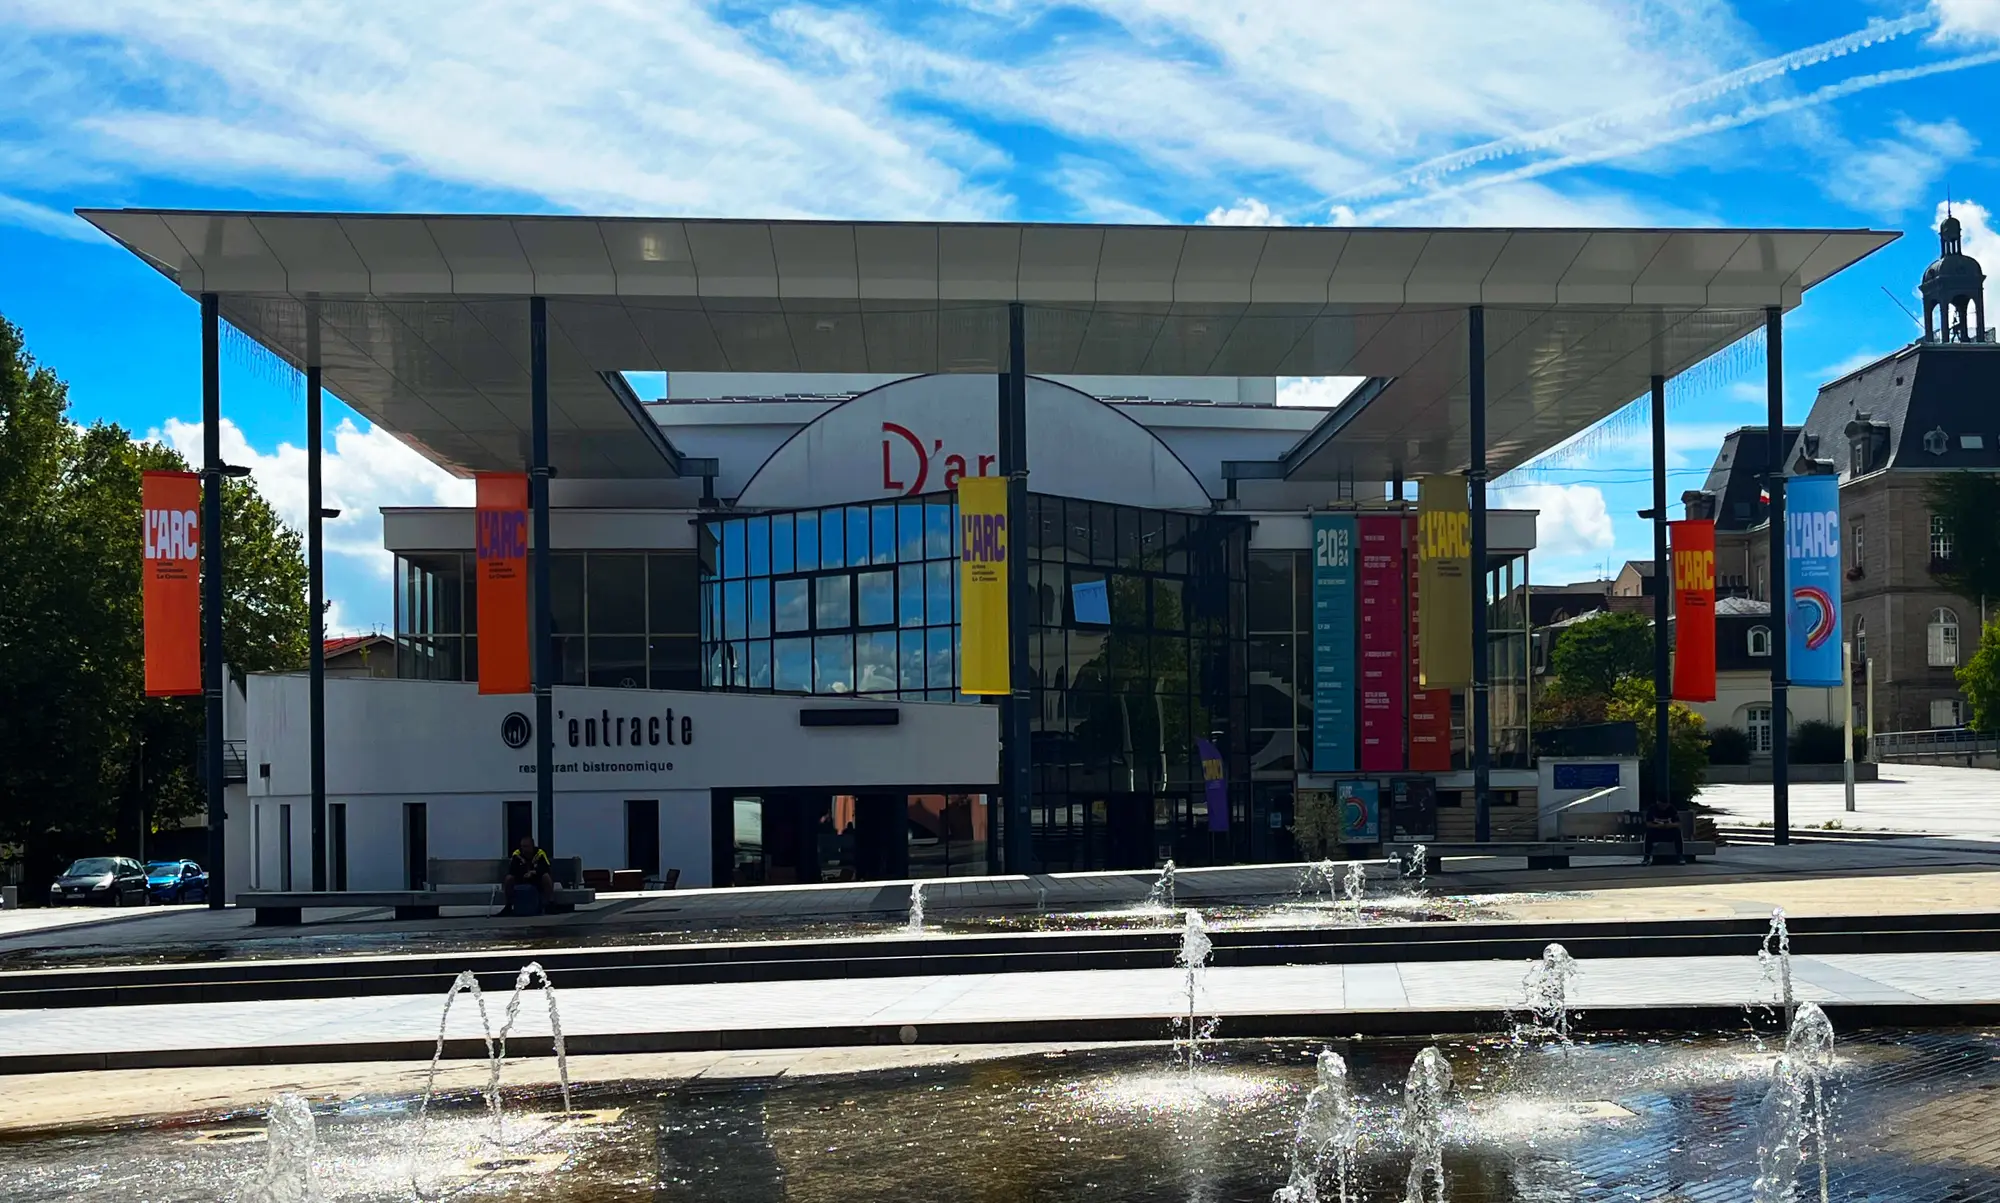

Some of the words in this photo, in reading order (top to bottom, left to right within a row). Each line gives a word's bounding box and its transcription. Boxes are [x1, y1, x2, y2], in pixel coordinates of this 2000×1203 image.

[144, 509, 197, 561] L'ARC
[478, 510, 525, 559] L'ARC
[961, 514, 1005, 562] L'ARC
[1317, 528, 1338, 567] 20
[1338, 529, 1348, 547] 23
[1427, 511, 1469, 559] L'ARC
[1790, 511, 1838, 558] L'ARC
[1338, 549, 1349, 567] 24
[1674, 550, 1714, 590] L'ARC
[552, 708, 692, 748] 'entracte
[519, 762, 578, 774] resrant
[583, 760, 673, 775] bistronomique
